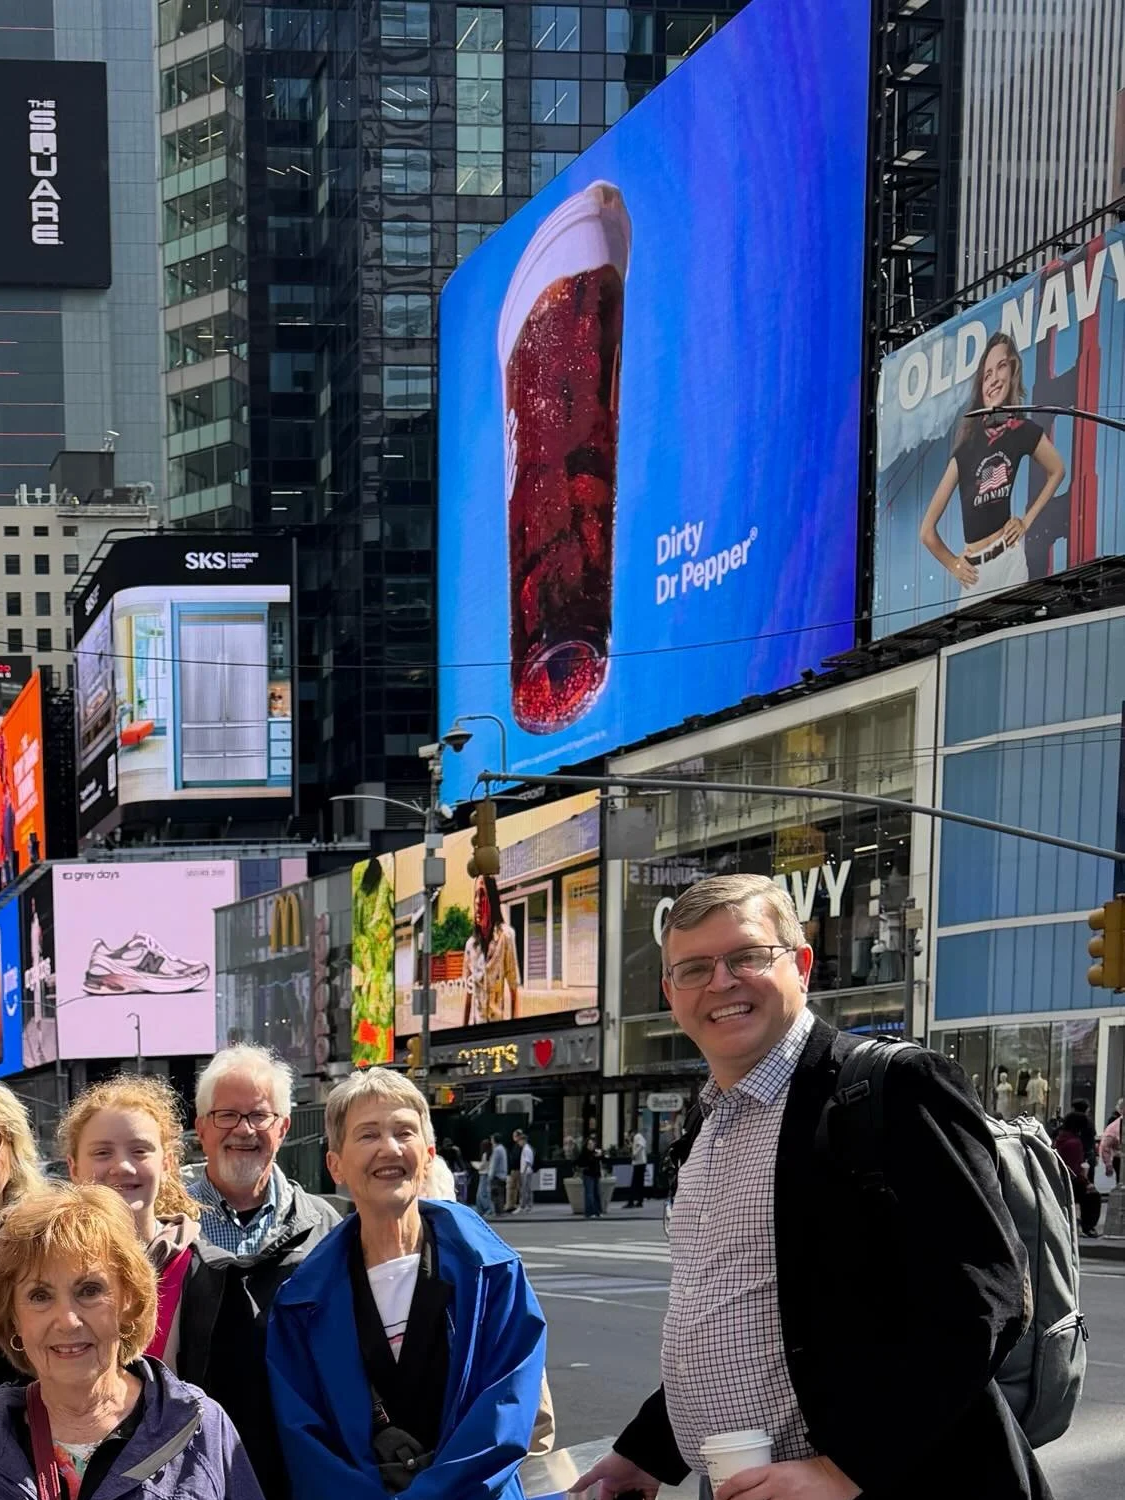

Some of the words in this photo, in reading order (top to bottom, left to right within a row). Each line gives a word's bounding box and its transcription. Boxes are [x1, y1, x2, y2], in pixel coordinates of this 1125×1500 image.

[28, 100, 56, 108] THE
[28, 110, 62, 245] SQUARE
[899, 321, 987, 410] OLD
[657, 520, 703, 565] Dirty
[185, 551, 226, 569] SKS
[657, 573, 678, 605] Dr
[74, 871, 95, 882] grey
[96, 870, 120, 881] days
